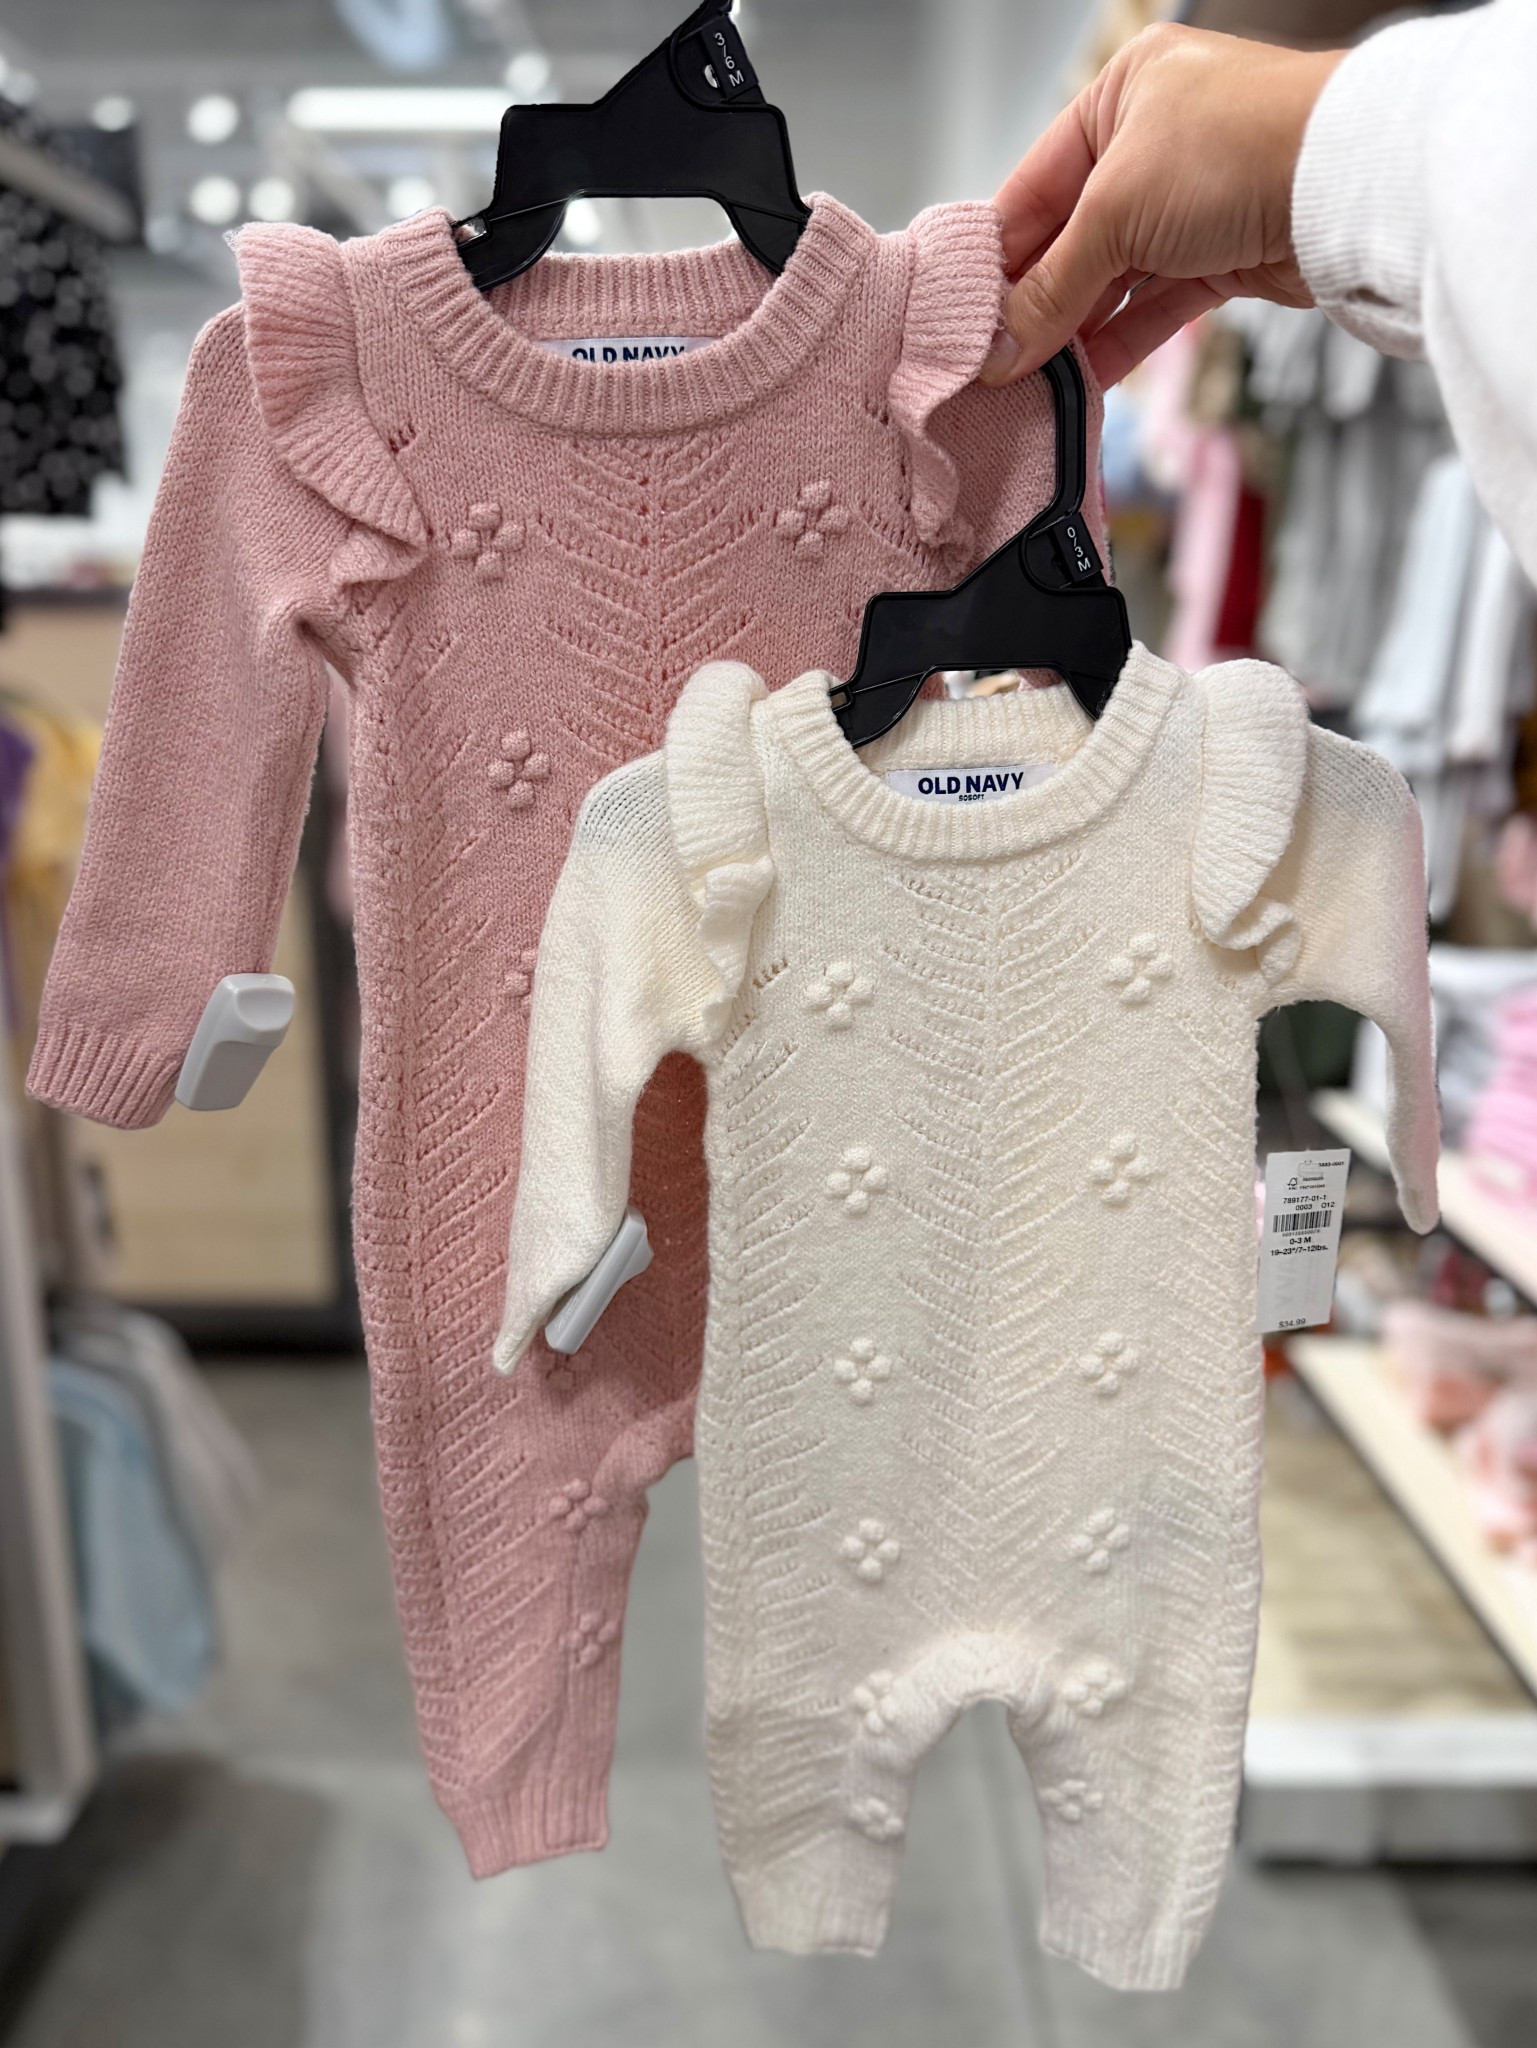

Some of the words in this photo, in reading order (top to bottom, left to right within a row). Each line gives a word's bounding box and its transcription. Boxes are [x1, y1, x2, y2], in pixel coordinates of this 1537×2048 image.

[918, 776, 960, 795] OLD
[966, 771, 1024, 794] NAVY
[1295, 1203, 1313, 1211] 0003
[1278, 1318, 1306, 1328] $34.99
